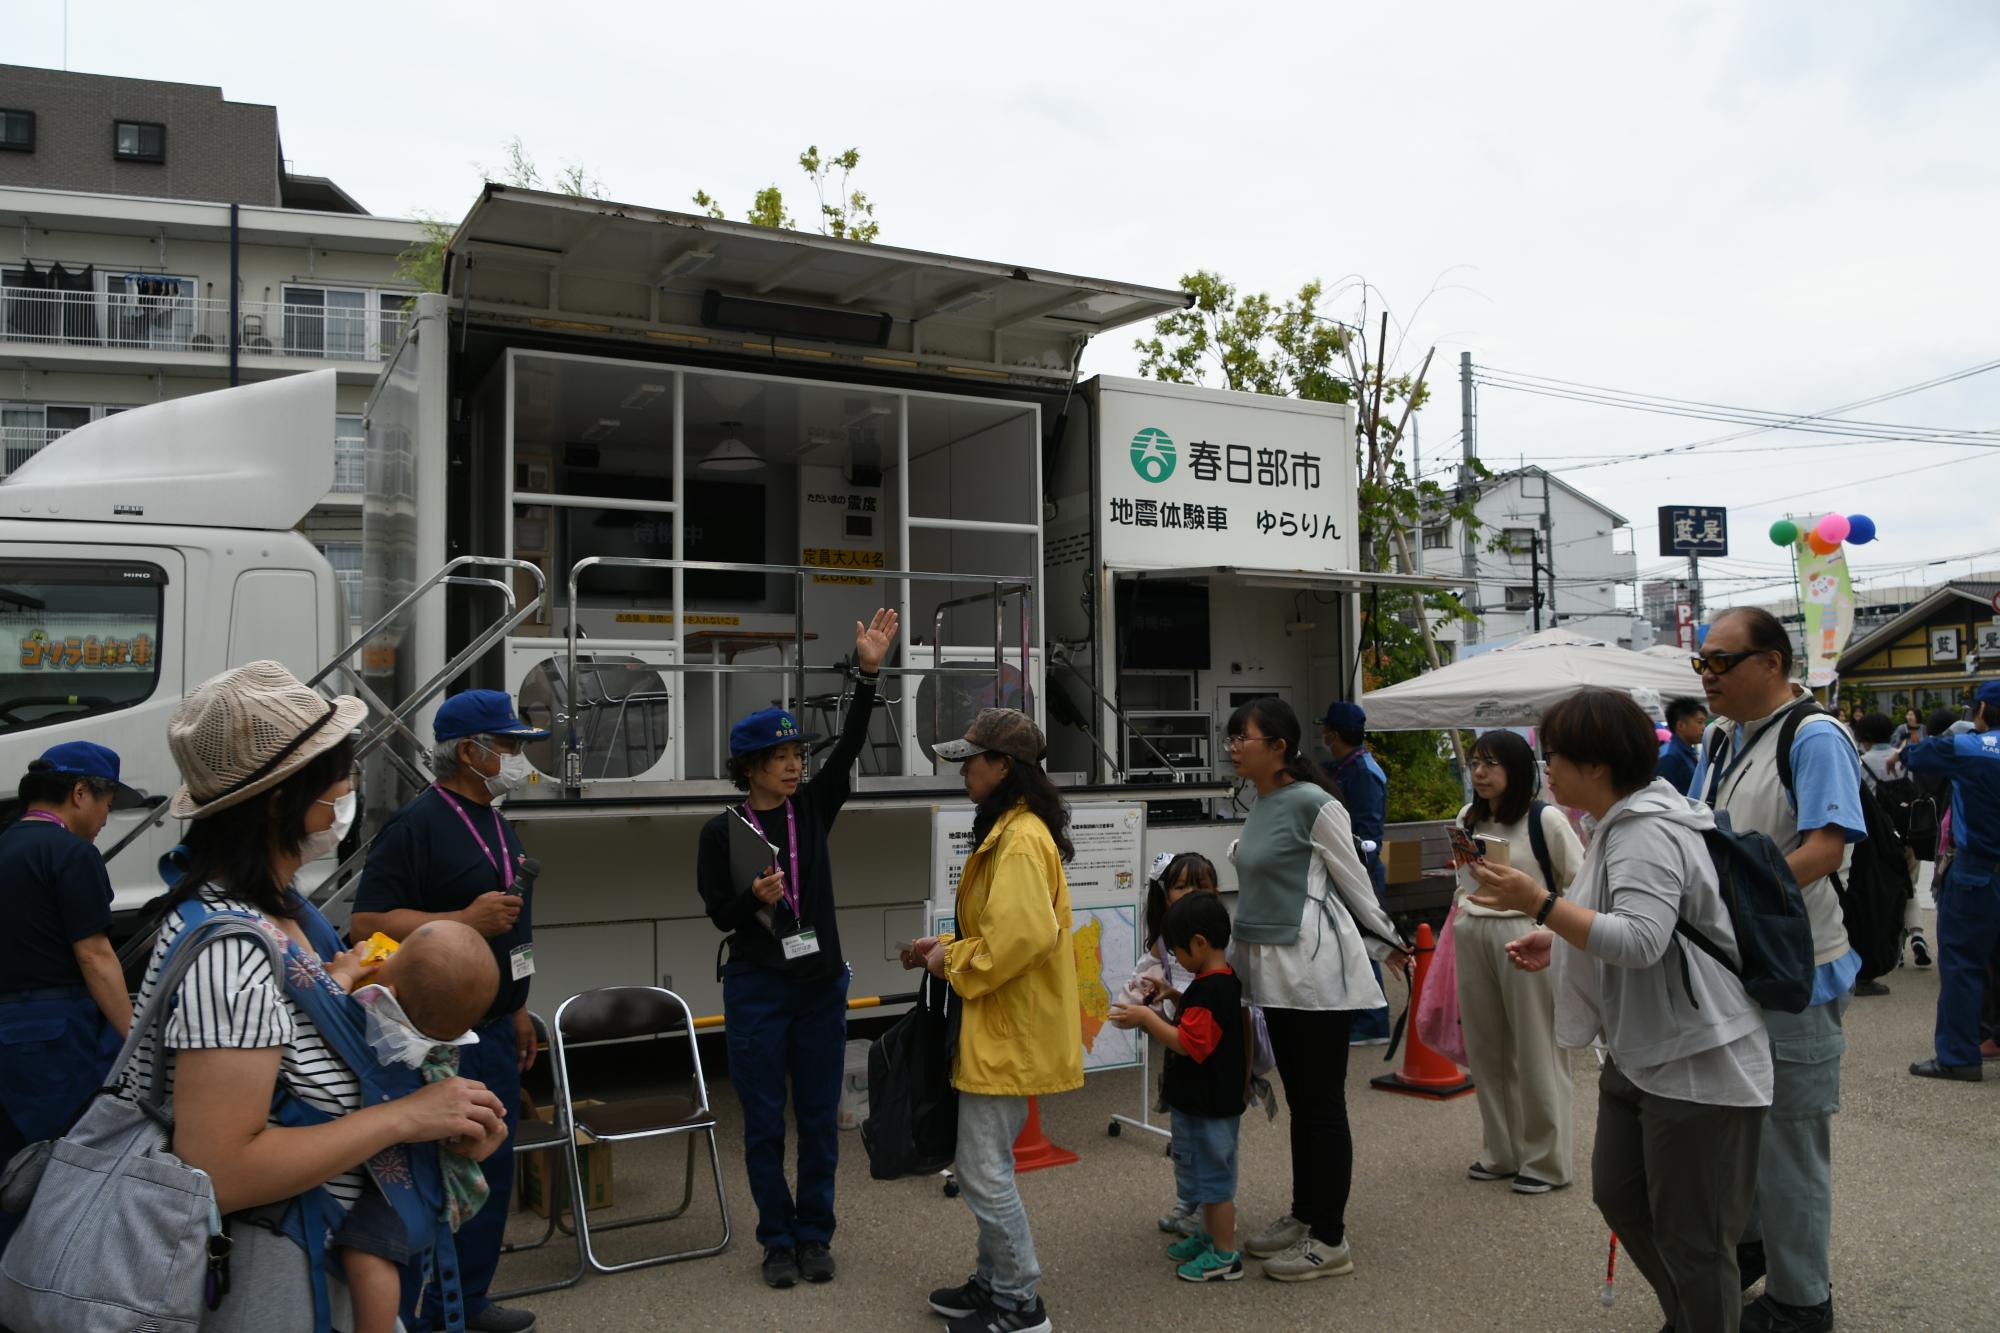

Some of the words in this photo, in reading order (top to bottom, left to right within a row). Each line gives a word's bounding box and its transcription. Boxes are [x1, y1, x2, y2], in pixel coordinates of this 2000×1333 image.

[1188, 440, 1321, 490] 春日部市
[1109, 497, 1228, 532] 地震体験車
[1256, 510, 1342, 540] ゆらりん
[803, 548, 884, 568] 定員大人4名
[1678, 605, 1691, 625] P
